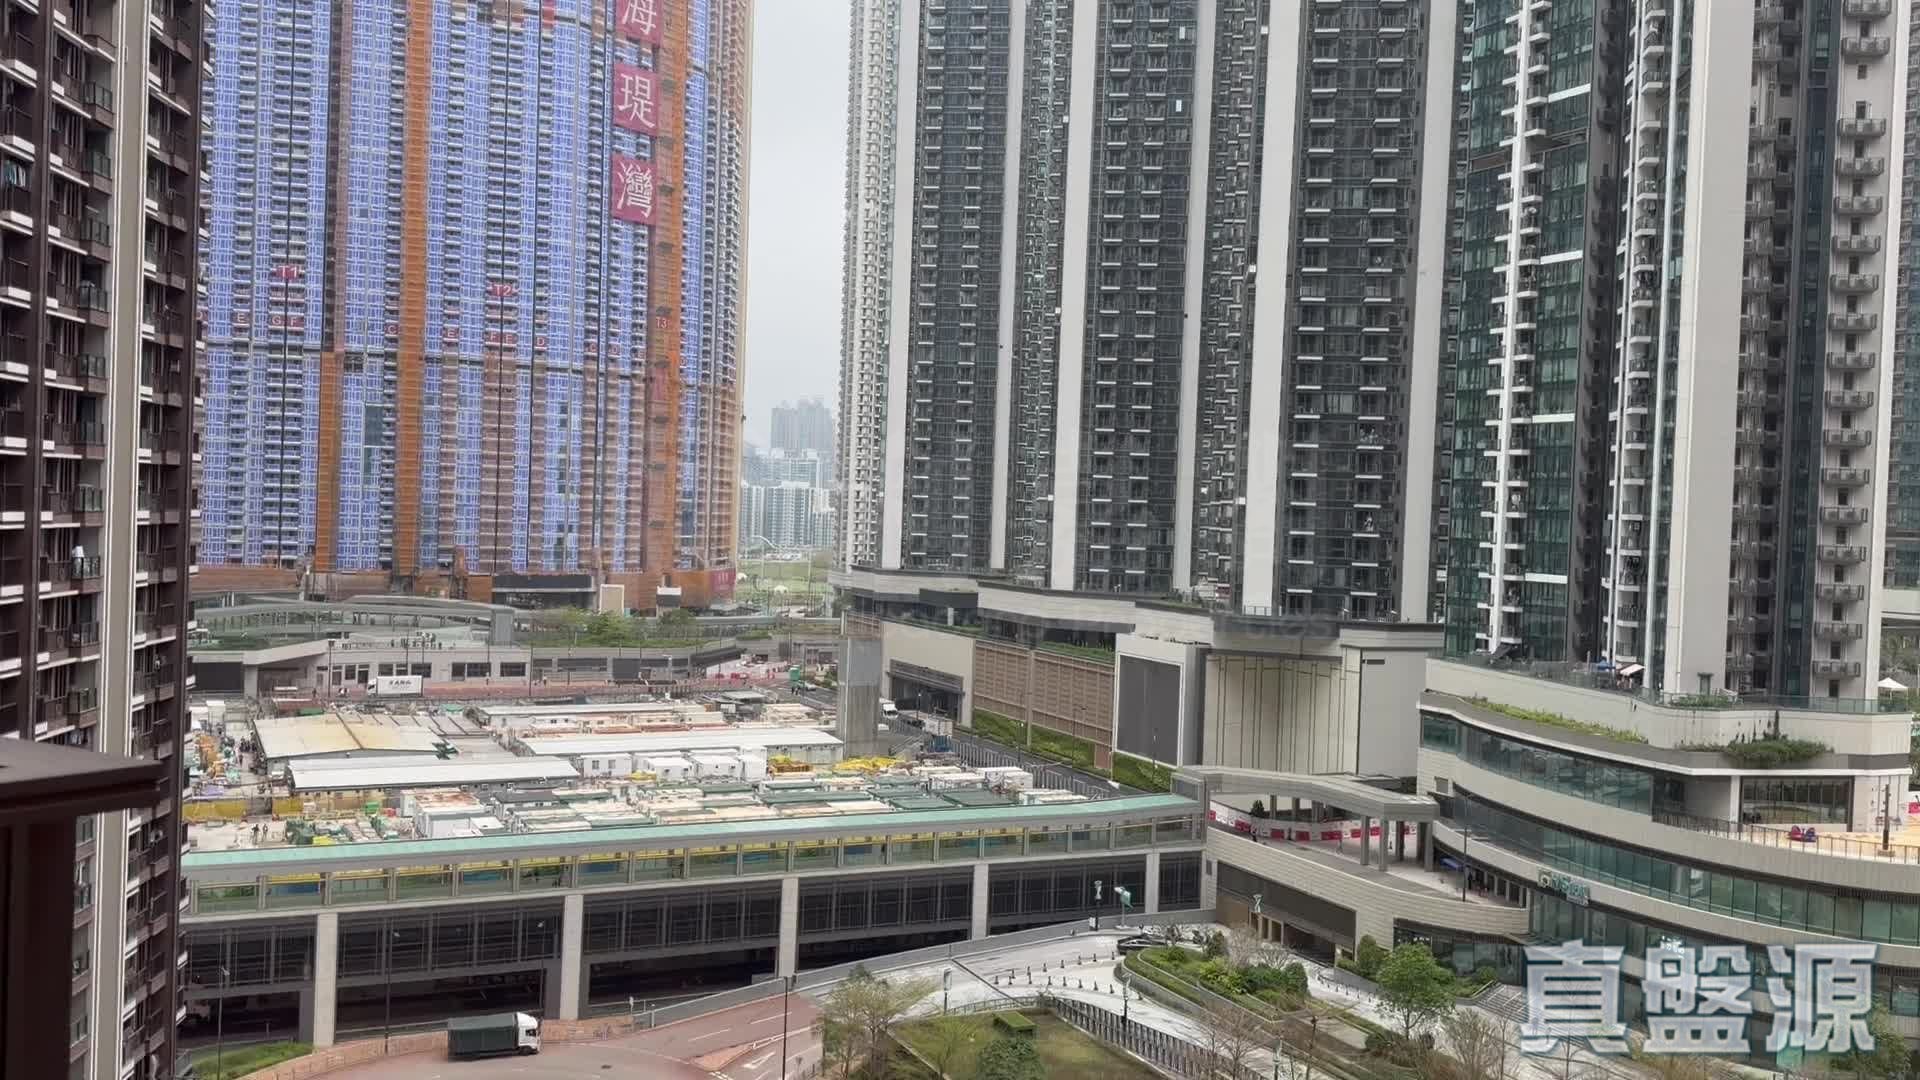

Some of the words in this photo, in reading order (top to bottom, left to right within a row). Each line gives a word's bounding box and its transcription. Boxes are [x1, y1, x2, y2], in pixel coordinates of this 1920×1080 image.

[617, 0, 657, 218] 海瑅灣
[279, 265, 298, 278] T1
[494, 284, 512, 297] T2
[237, 312, 245, 322] E
[272, 315, 281, 325] G
[387, 325, 397, 335] C
[447, 329, 456, 338] E
[537, 337, 545, 346] D
